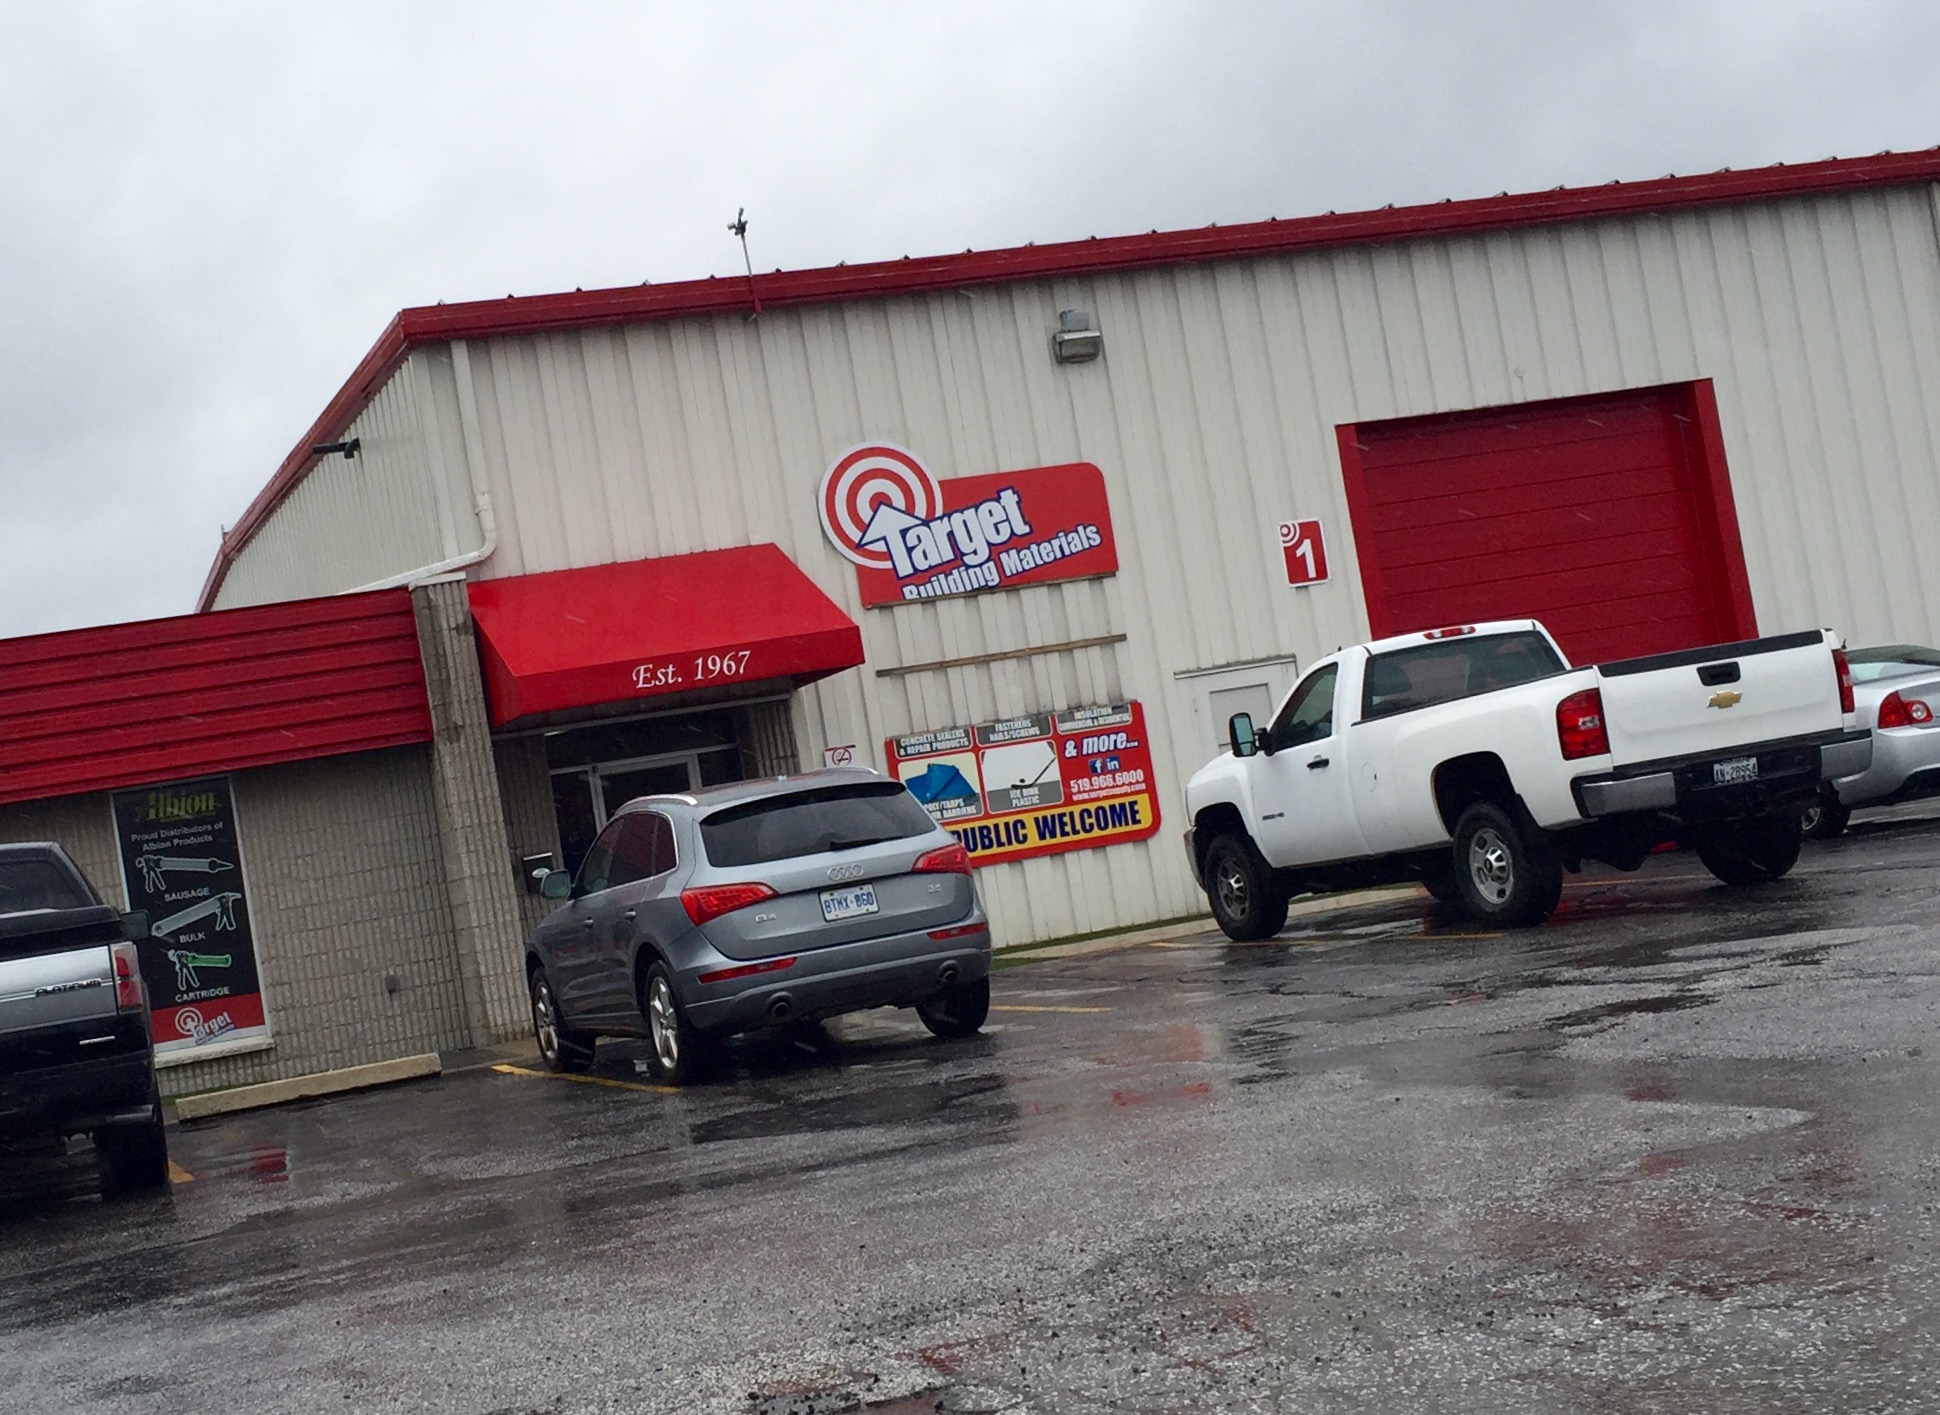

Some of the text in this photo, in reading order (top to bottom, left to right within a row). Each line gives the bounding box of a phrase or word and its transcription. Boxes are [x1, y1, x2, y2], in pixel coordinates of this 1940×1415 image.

[857, 486, 1031, 580] Target
[902, 524, 1102, 600] Building Materials
[1296, 538, 1317, 579] 1
[632, 650, 751, 689] Est. 1967
[932, 737, 969, 751] PRODUCTS
[1064, 732, 1139, 758] & more...
[1070, 769, 1144, 793] 519.966.6000
[1012, 795, 1040, 808] PLASTIC
[131, 821, 223, 842] Proud Distributors of
[952, 800, 1142, 853] PUBLIC WELCOME
[142, 834, 213, 851] Albion Products
[164, 887, 210, 902] SAUSAGE
[179, 931, 206, 944] BULK
[175, 986, 230, 1003] CARTRIDGE
